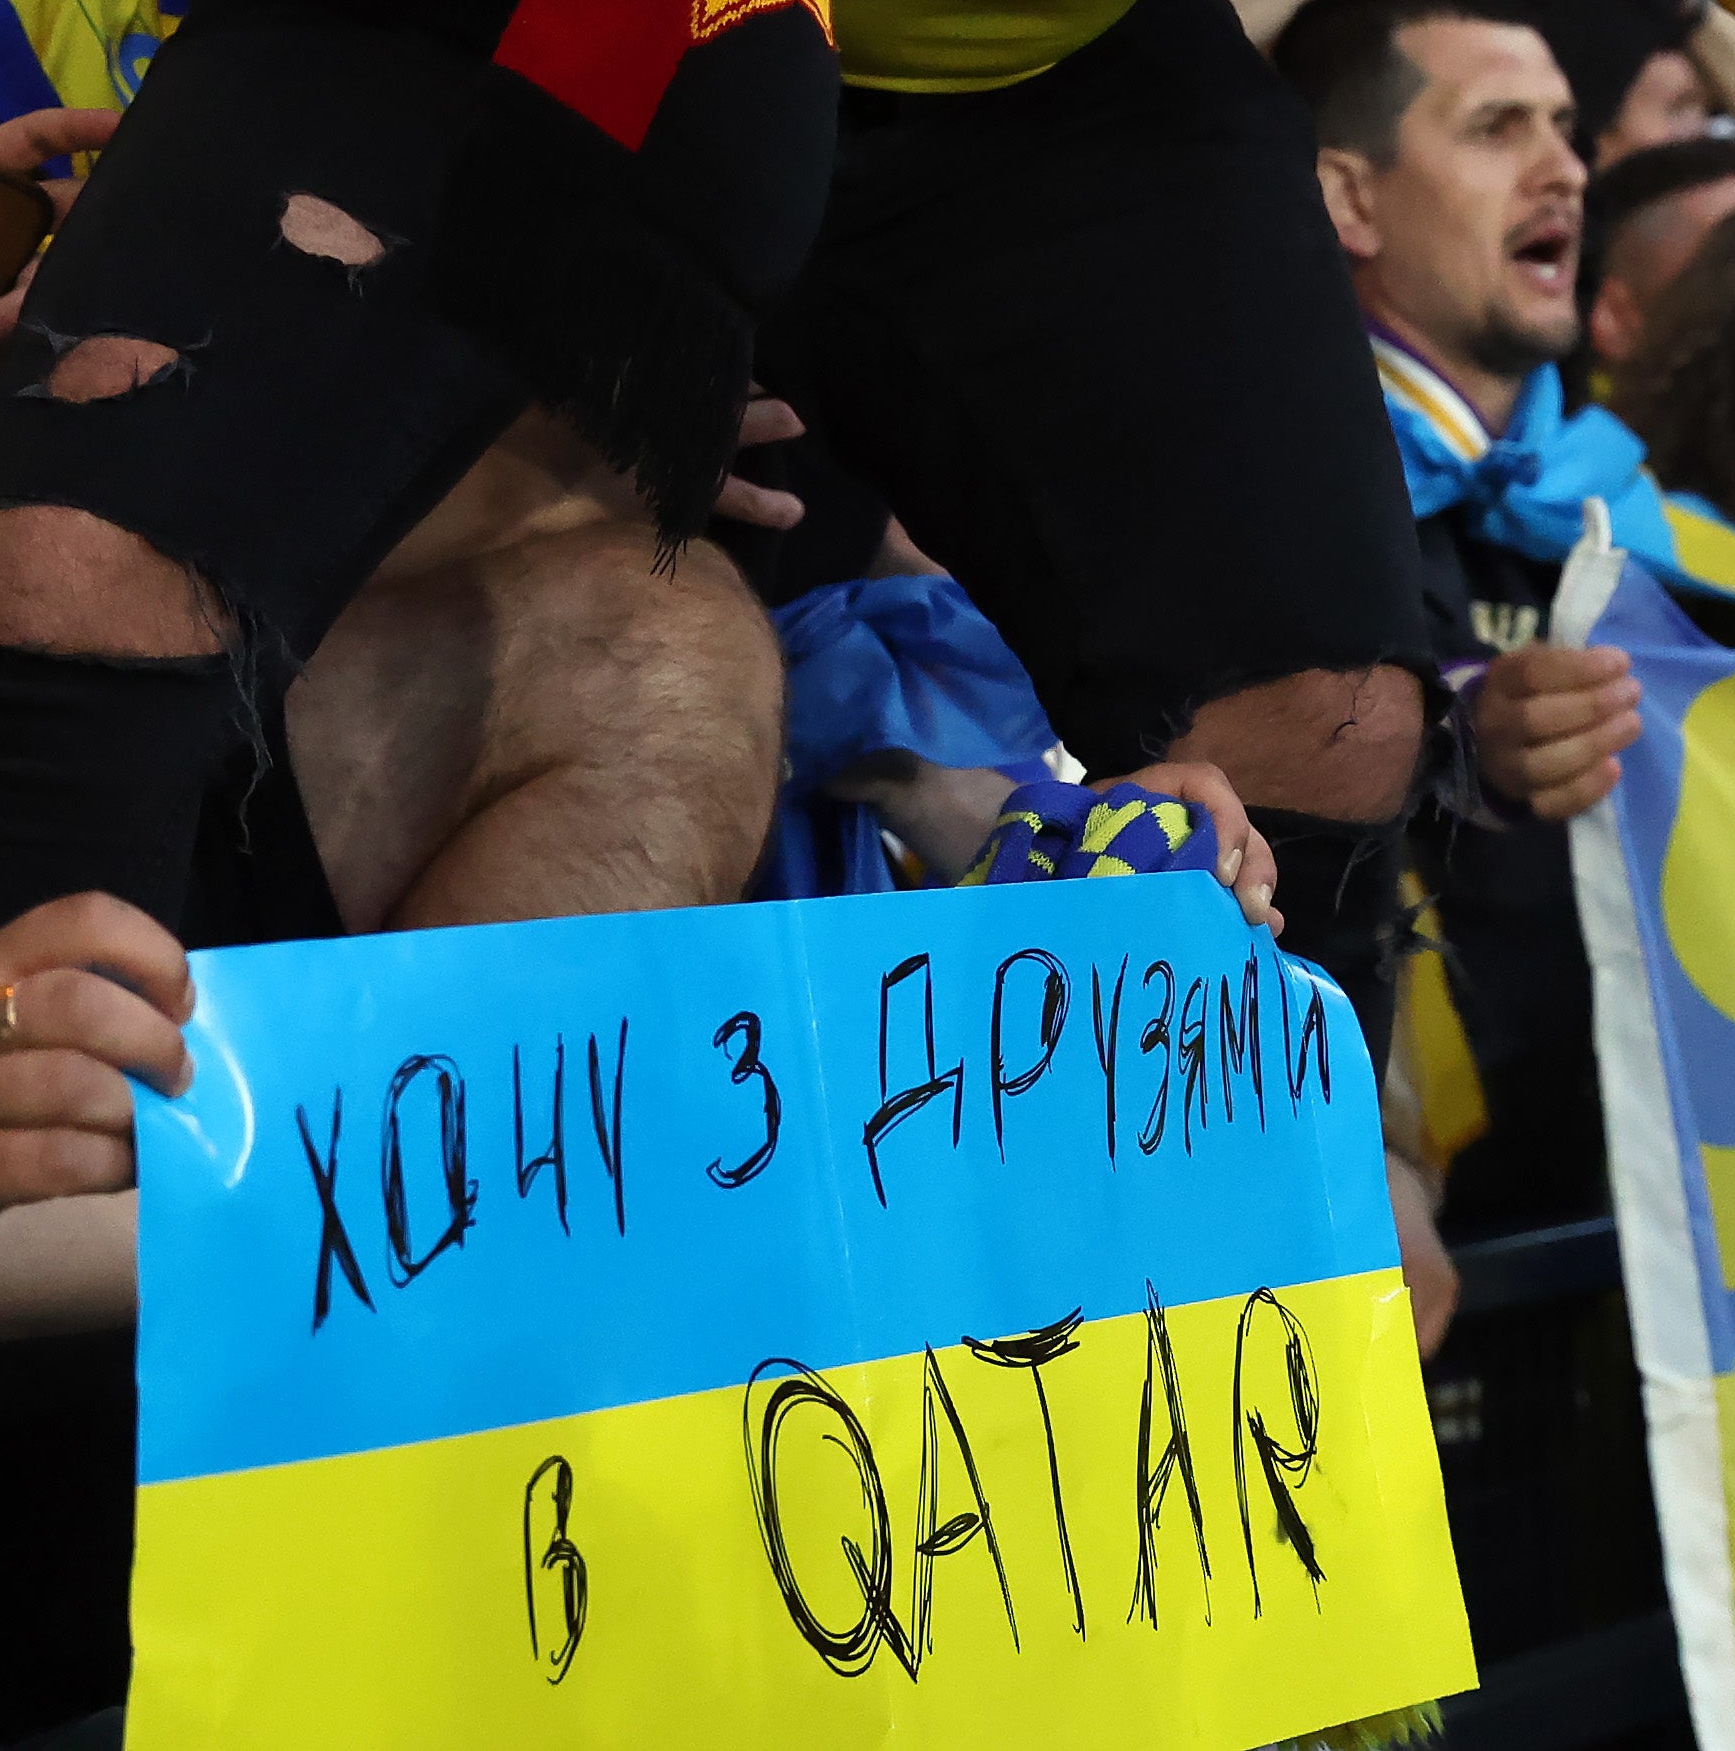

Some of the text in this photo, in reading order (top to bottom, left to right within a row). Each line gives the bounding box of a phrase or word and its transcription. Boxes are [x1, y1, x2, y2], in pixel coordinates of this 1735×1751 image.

[294, 1015, 628, 1331] ХОЧУ
[863, 938, 1332, 1210] ДРУЗЯМИ
[740, 1275, 1324, 1684] QATAR
